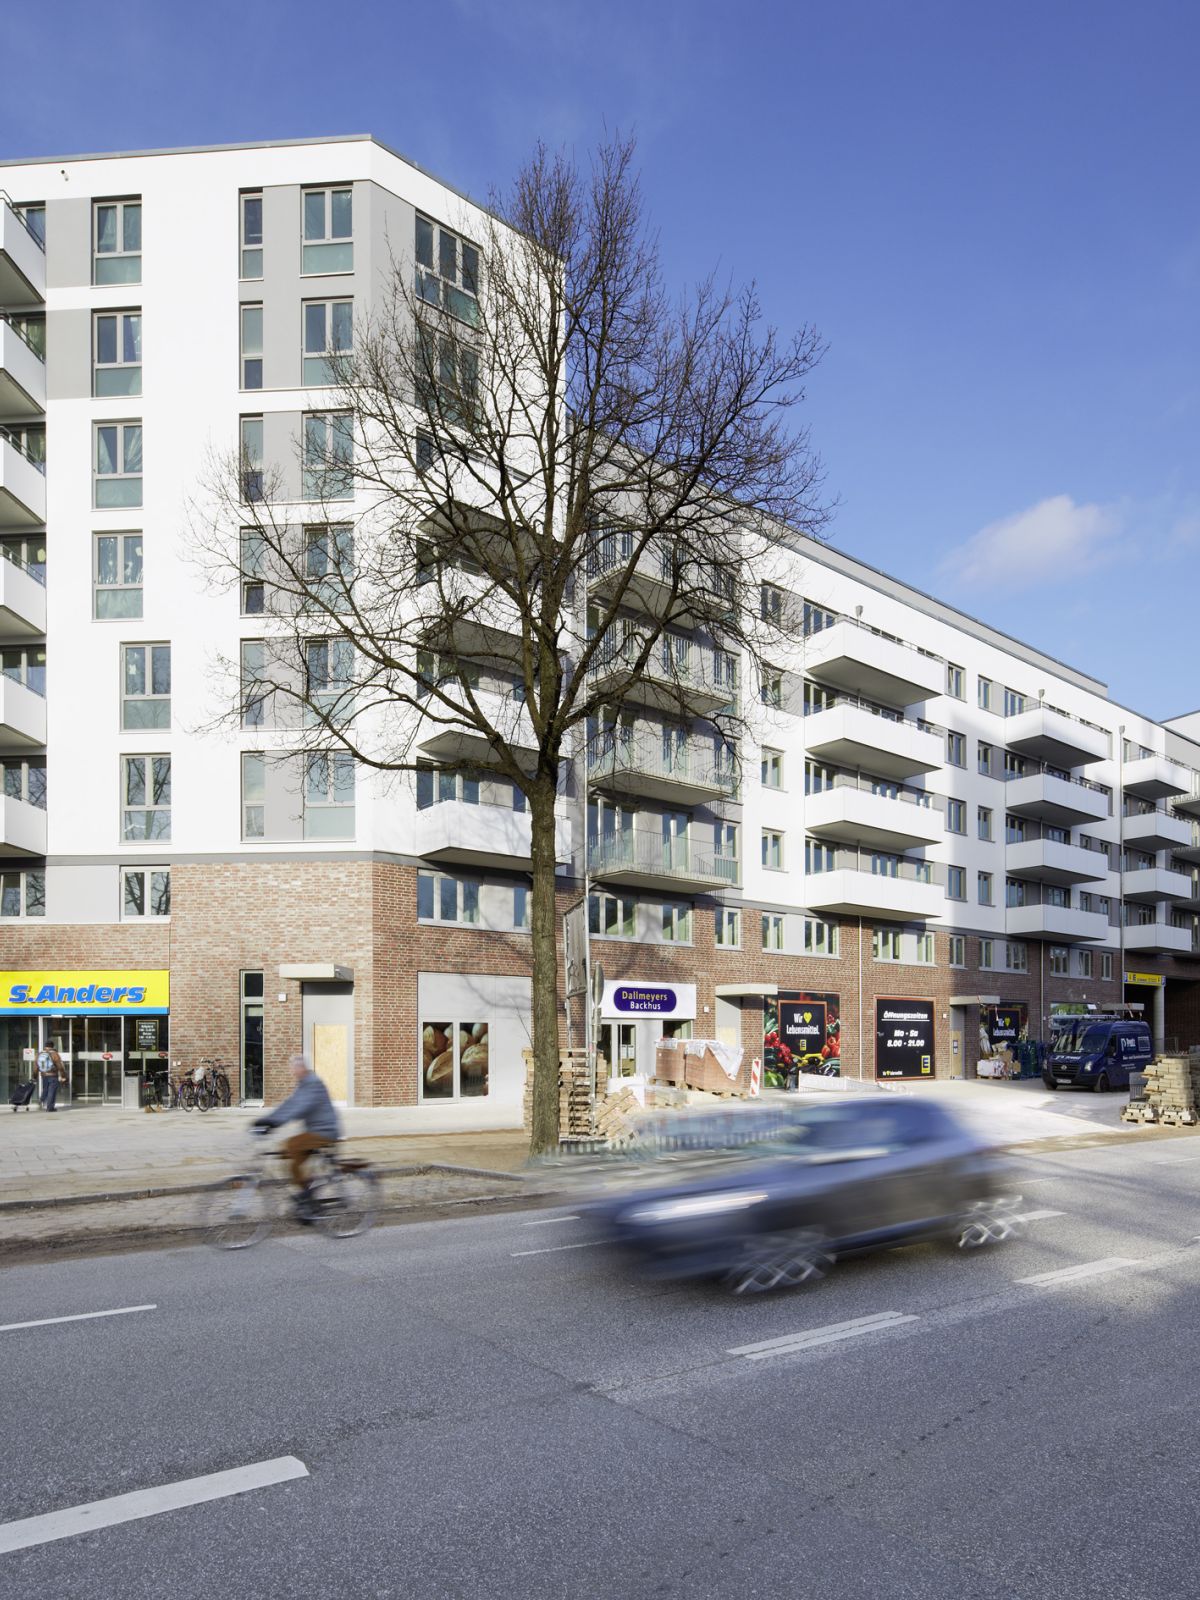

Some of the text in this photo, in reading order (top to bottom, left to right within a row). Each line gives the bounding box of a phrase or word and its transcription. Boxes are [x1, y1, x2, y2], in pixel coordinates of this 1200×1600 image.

[9, 984, 146, 1003] S.Anders
[622, 990, 668, 1002] Dallmeyers
[630, 1001, 661, 1010] Backhus
[883, 1010, 928, 1020] Öffnungszeiten
[887, 1039, 903, 1047] 8.00
[907, 1039, 925, 1047] 21.00
